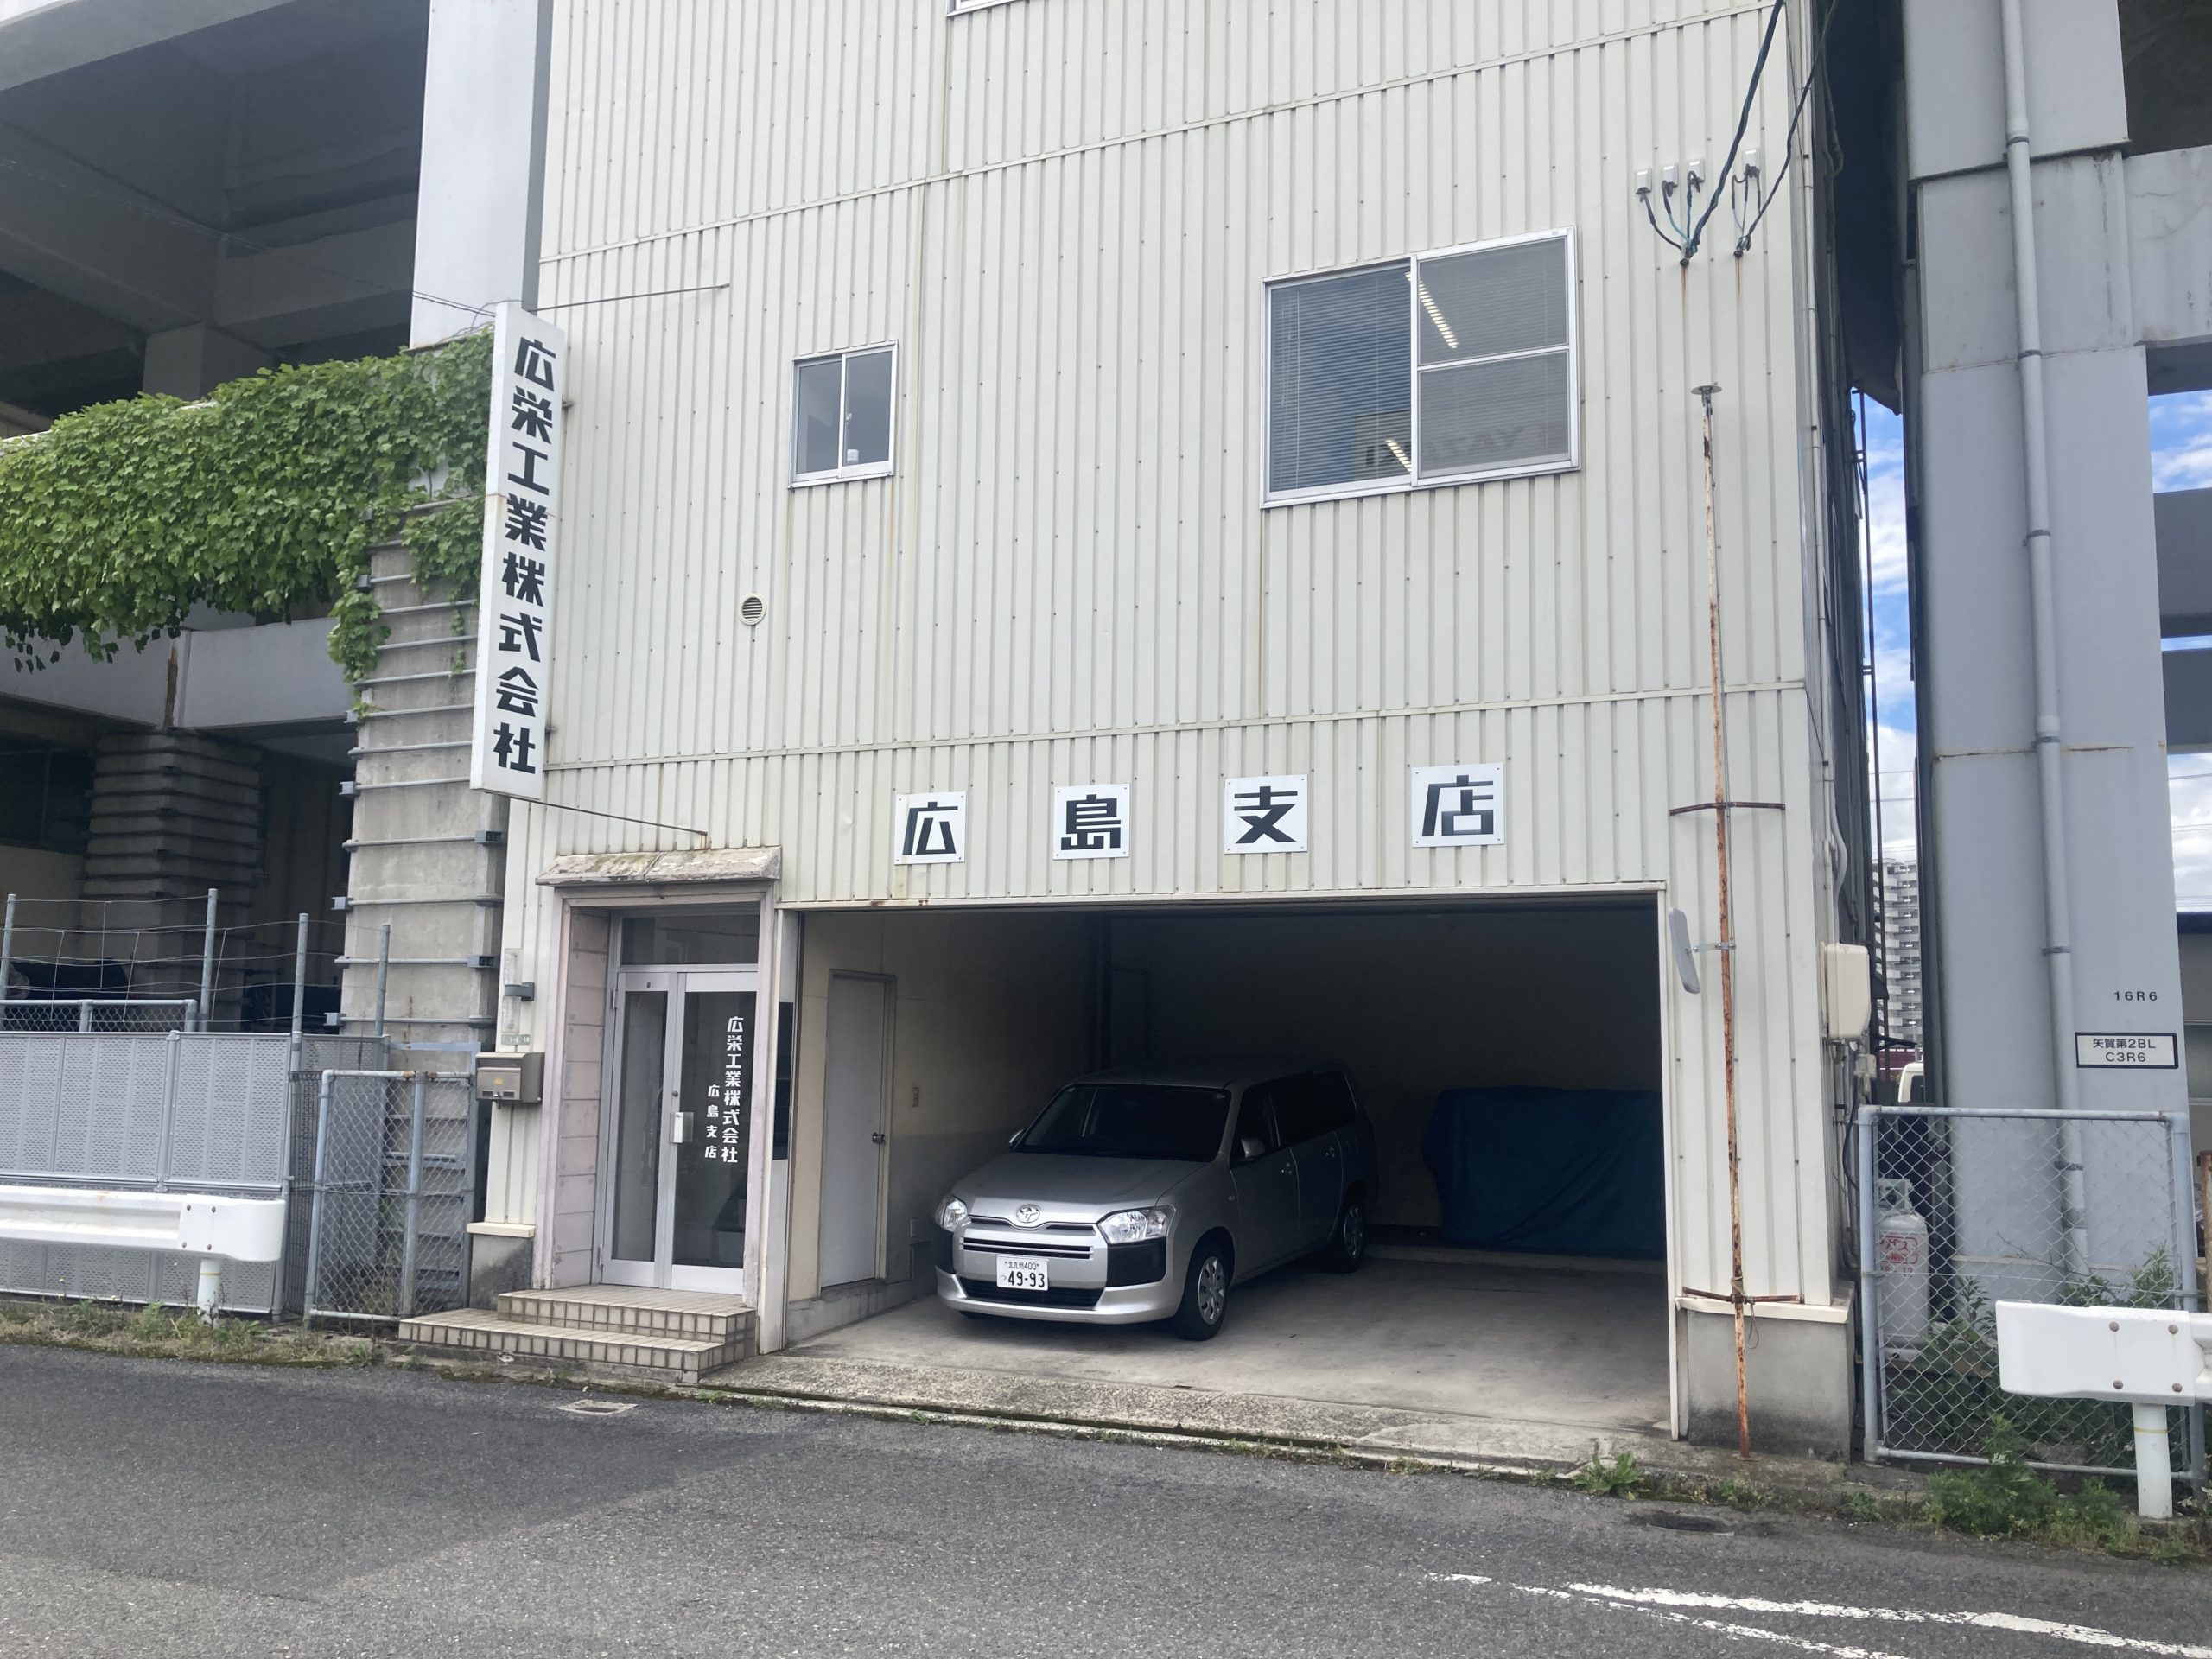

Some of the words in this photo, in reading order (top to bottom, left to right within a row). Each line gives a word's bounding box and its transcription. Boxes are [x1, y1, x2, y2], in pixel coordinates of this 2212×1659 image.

[493, 335, 557, 776] 広栄工業株式会社
[902, 774, 1495, 856] 広島支店
[2113, 991, 2158, 1001] 16R6
[2093, 1039, 2156, 1049] 矢賀第2BL
[2105, 1052, 2146, 1062] C3R6
[721, 1015, 744, 1163] 広栄工業株式会社
[704, 1084, 721, 1159] 広島支店
[1007, 1270, 1045, 1288] 49-93
